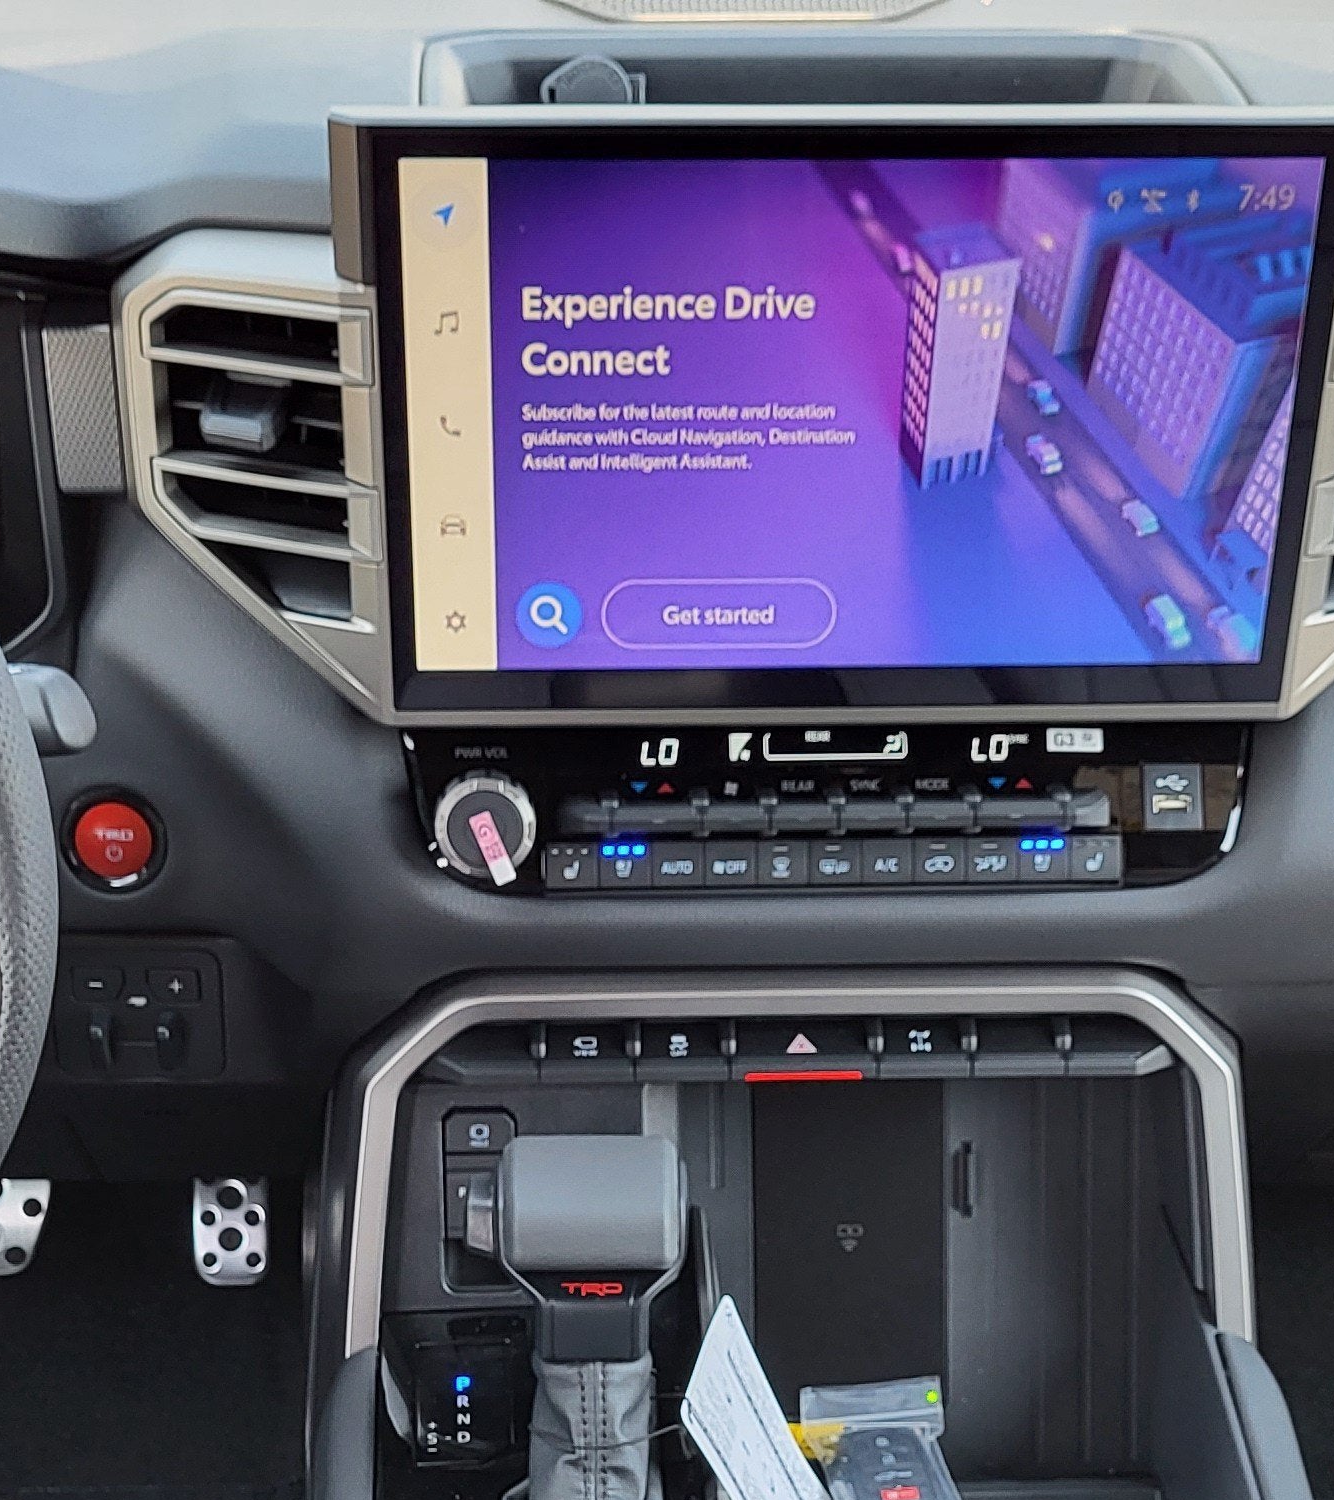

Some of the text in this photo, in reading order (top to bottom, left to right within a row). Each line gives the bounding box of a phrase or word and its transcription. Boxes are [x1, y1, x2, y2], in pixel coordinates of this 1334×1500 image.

[1238, 184, 1296, 212] 7:49
[521, 285, 816, 329] Experience Drive
[521, 342, 671, 377] Connect
[521, 402, 836, 422] Subscribe for the latest route and location
[521, 427, 856, 450] guidance with Cloud Navigation, Destination
[521, 453, 752, 473] Assist and Intelligent Assistant.
[662, 604, 775, 626] Get started
[640, 738, 680, 767] LO
[660, 860, 694, 875] AUTO
[561, 1282, 622, 1297] TRD
[456, 1376, 471, 1391] P
[457, 1395, 470, 1408] R
[457, 1413, 471, 1425] N
[427, 1432, 438, 1445] S
[457, 1431, 471, 1443] D
